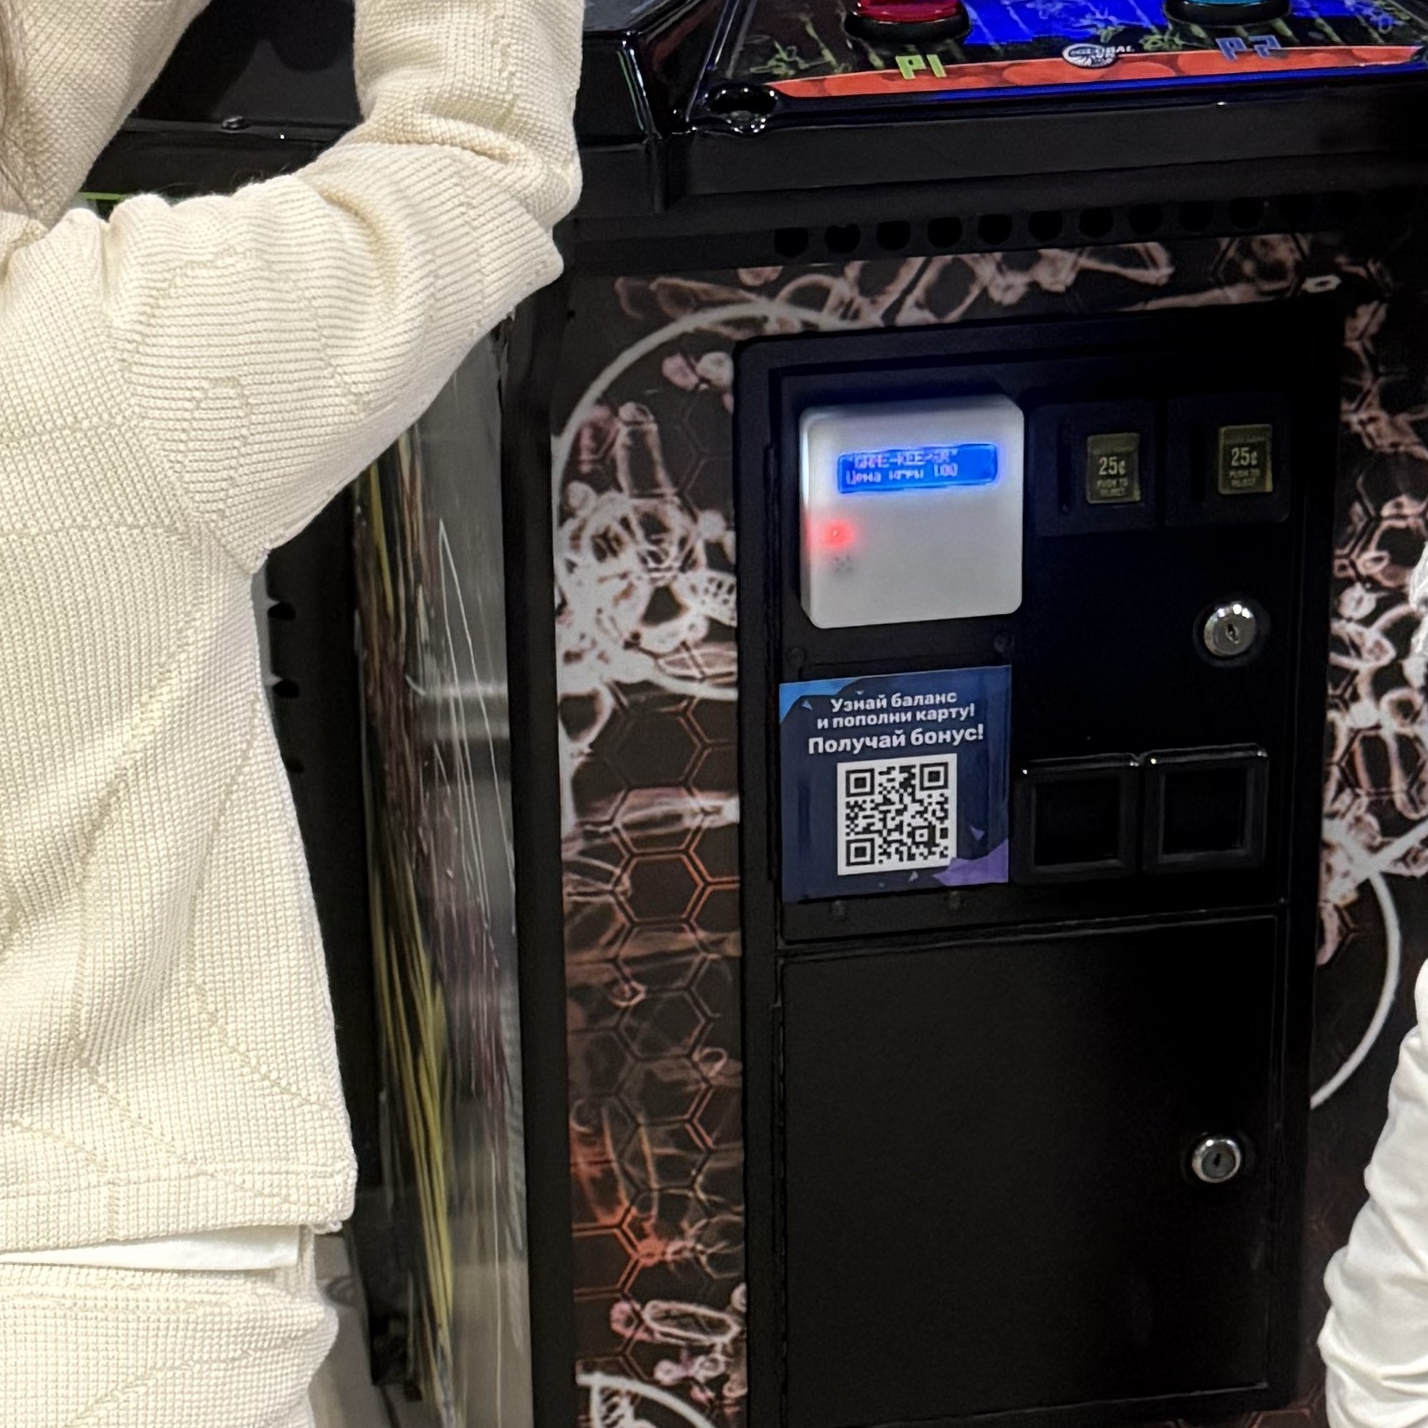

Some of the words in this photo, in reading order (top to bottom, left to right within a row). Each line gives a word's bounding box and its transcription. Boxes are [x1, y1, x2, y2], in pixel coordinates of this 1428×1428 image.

[1215, 35, 1282, 62] P2
[894, 53, 947, 80] P1
[817, 718, 829, 729] и
[832, 712, 912, 729] пополни
[916, 703, 975, 722] карту!
[830, 694, 887, 713] Узнай
[891, 692, 957, 708] баланс
[808, 729, 906, 754] Получай
[910, 724, 984, 747] бонус!
